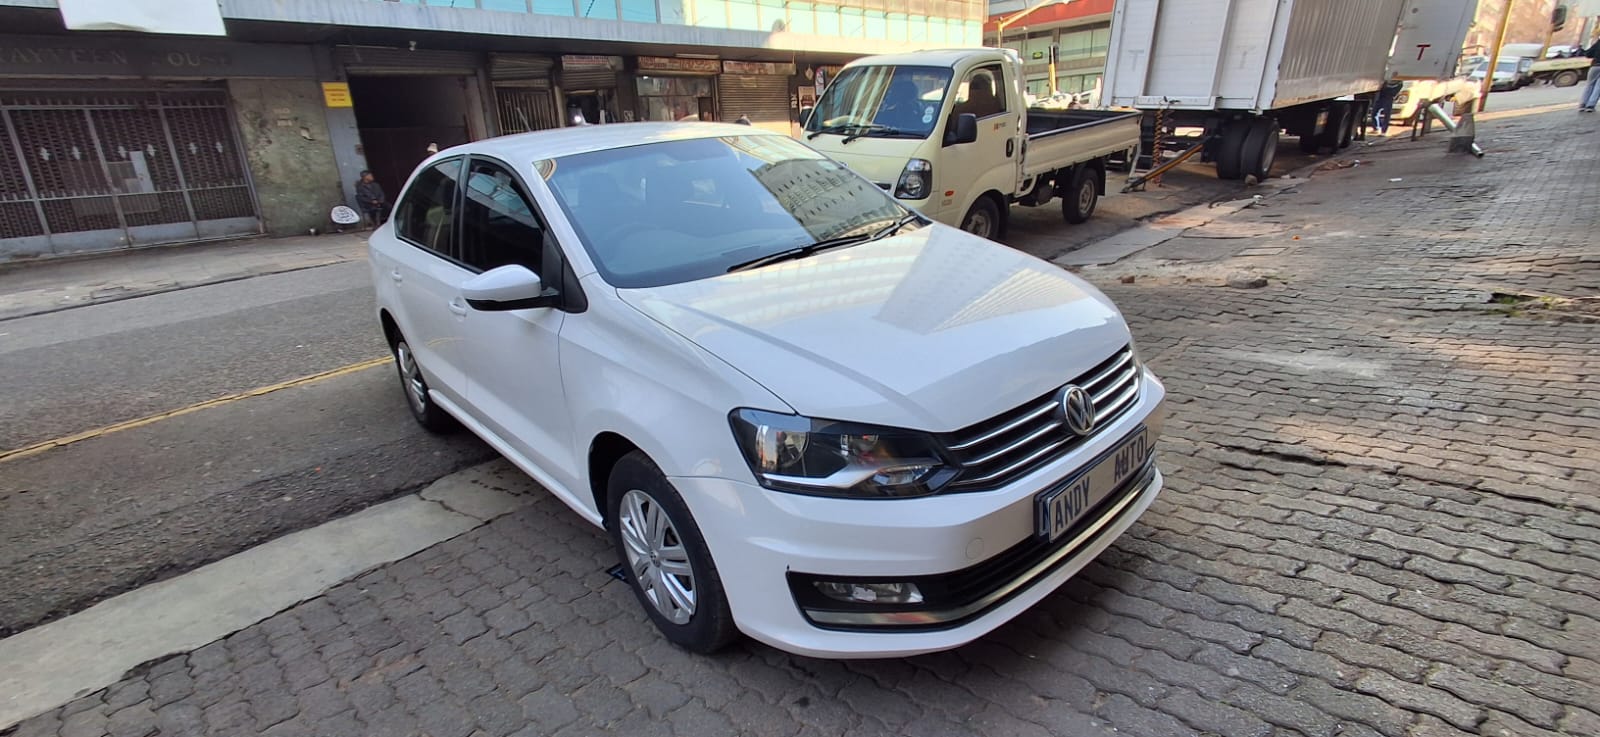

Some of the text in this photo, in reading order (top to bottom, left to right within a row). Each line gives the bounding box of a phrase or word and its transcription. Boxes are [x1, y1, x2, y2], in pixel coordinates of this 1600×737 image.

[1416, 44, 1431, 61] T
[1055, 435, 1144, 532] ANDY AUTO
